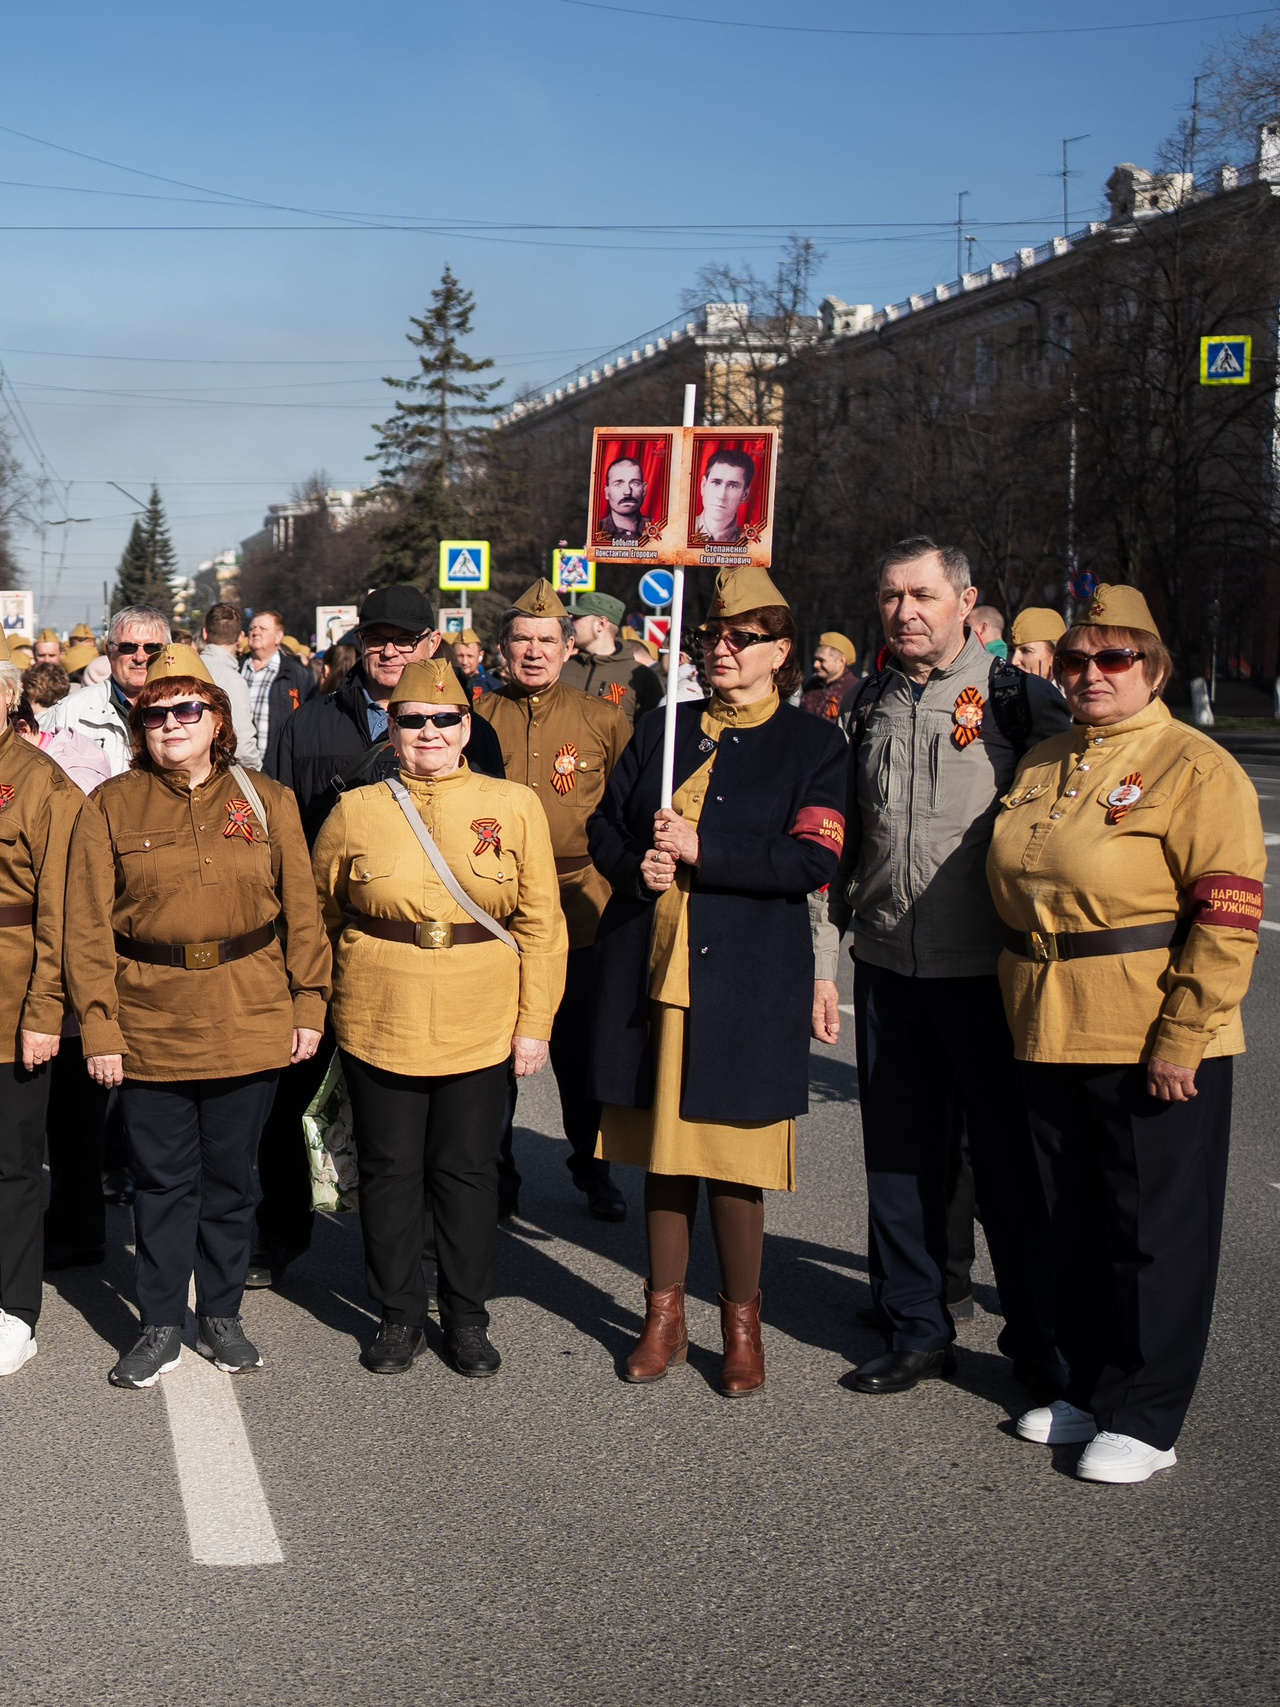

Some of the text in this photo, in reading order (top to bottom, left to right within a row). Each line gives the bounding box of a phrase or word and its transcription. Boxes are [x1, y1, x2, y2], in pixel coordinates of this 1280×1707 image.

[612, 538, 639, 547] Бобылев
[595, 549, 658, 560] Константин Егорович
[704, 544, 748, 554] Степаненко
[700, 554, 751, 565] Егор Иванович
[1211, 889, 1262, 906] НАРОДНЫЙ
